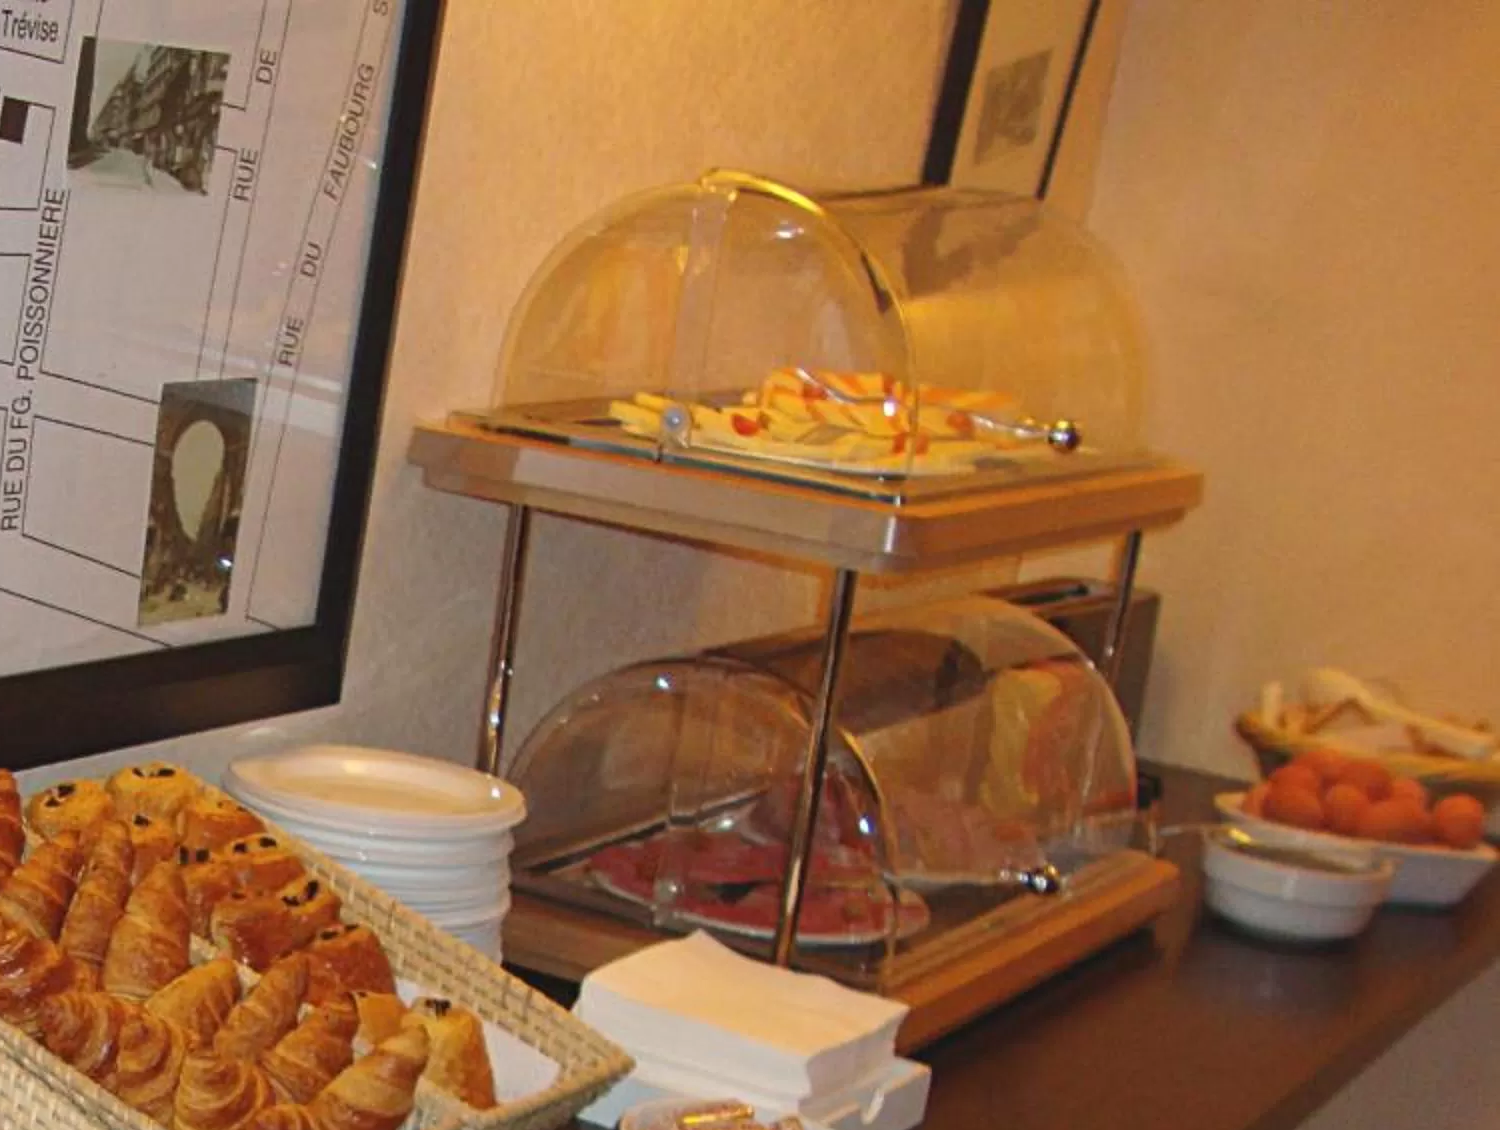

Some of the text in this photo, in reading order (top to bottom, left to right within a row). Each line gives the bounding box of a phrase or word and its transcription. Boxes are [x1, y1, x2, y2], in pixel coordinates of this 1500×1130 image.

[1, 9, 60, 43] Trévise
[233, 48, 277, 202] RUE DE
[278, 315, 304, 368] RUE
[300, 243, 323, 279] DU
[323, 62, 375, 202] FAUBOURG
[2, 188, 66, 531] RUE DU FG. POISSONNIERE
